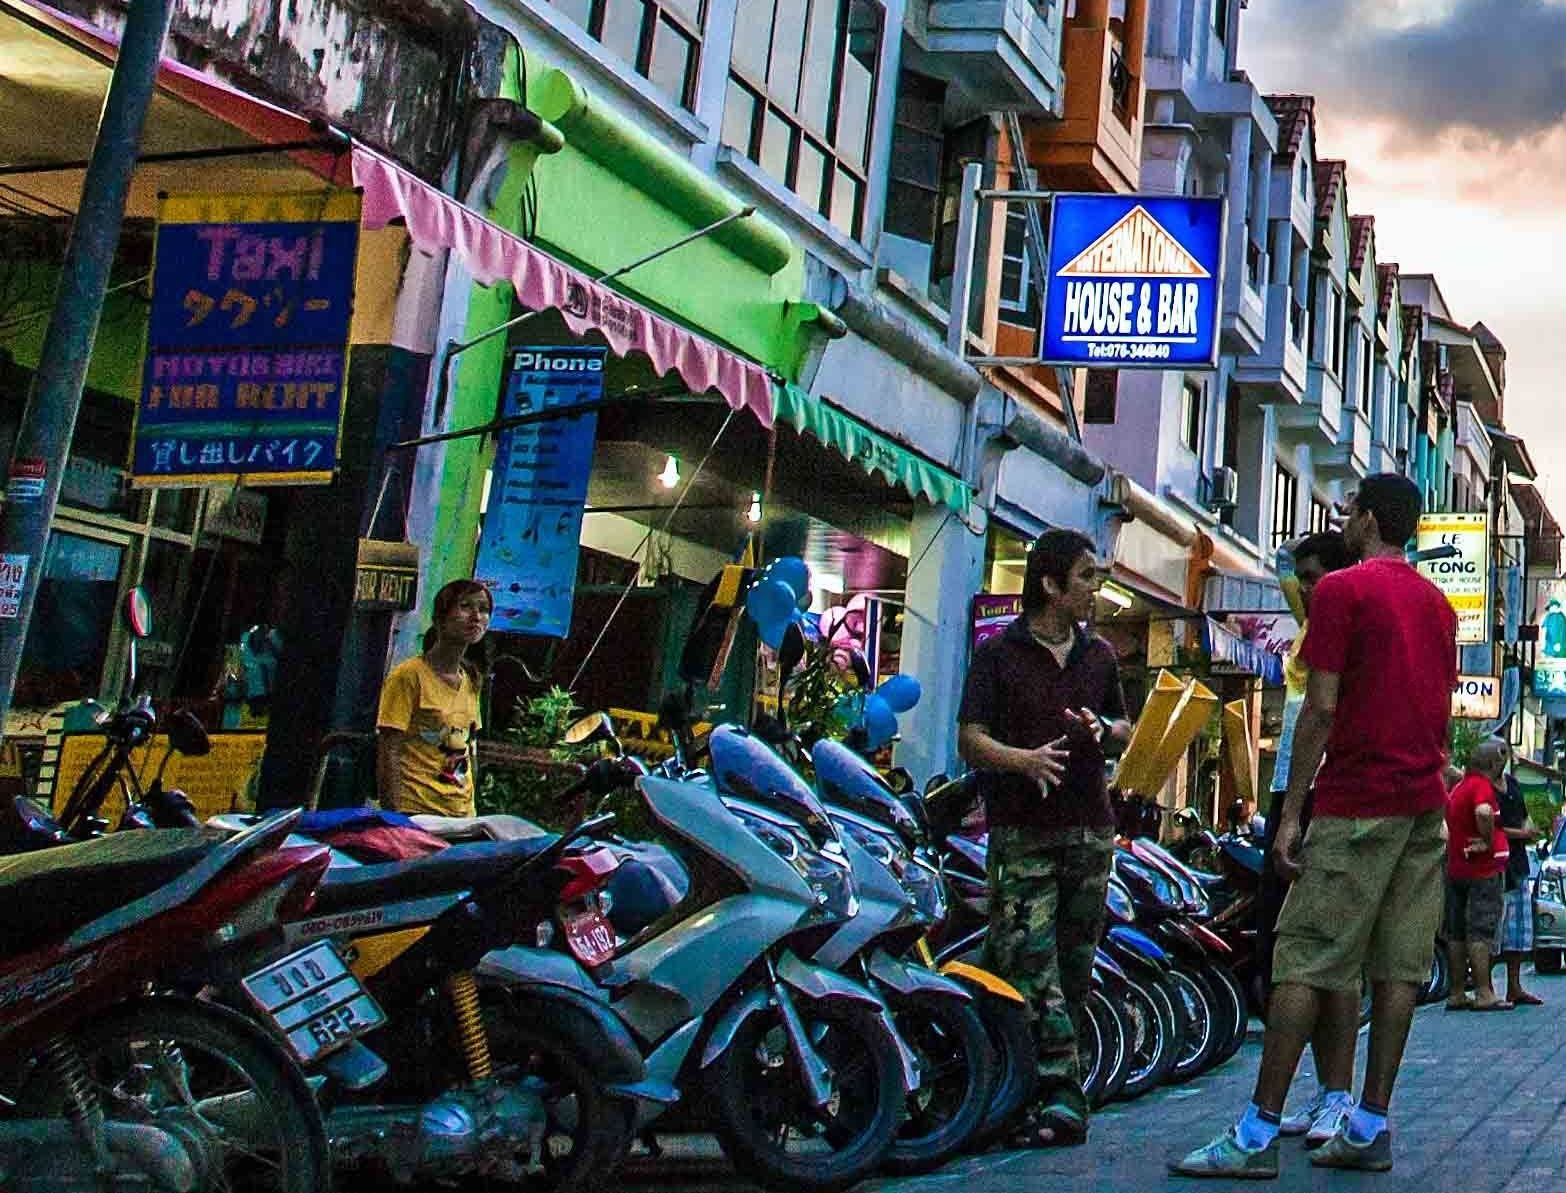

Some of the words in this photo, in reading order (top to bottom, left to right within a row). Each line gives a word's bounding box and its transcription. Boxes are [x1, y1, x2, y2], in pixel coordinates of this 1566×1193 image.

[1064, 281, 1135, 334] HOUSE
[1137, 282, 1151, 335] &
[1157, 283, 1199, 335] BAR
[513, 353, 602, 372] Phone
[1428, 562, 1476, 574] TONG
